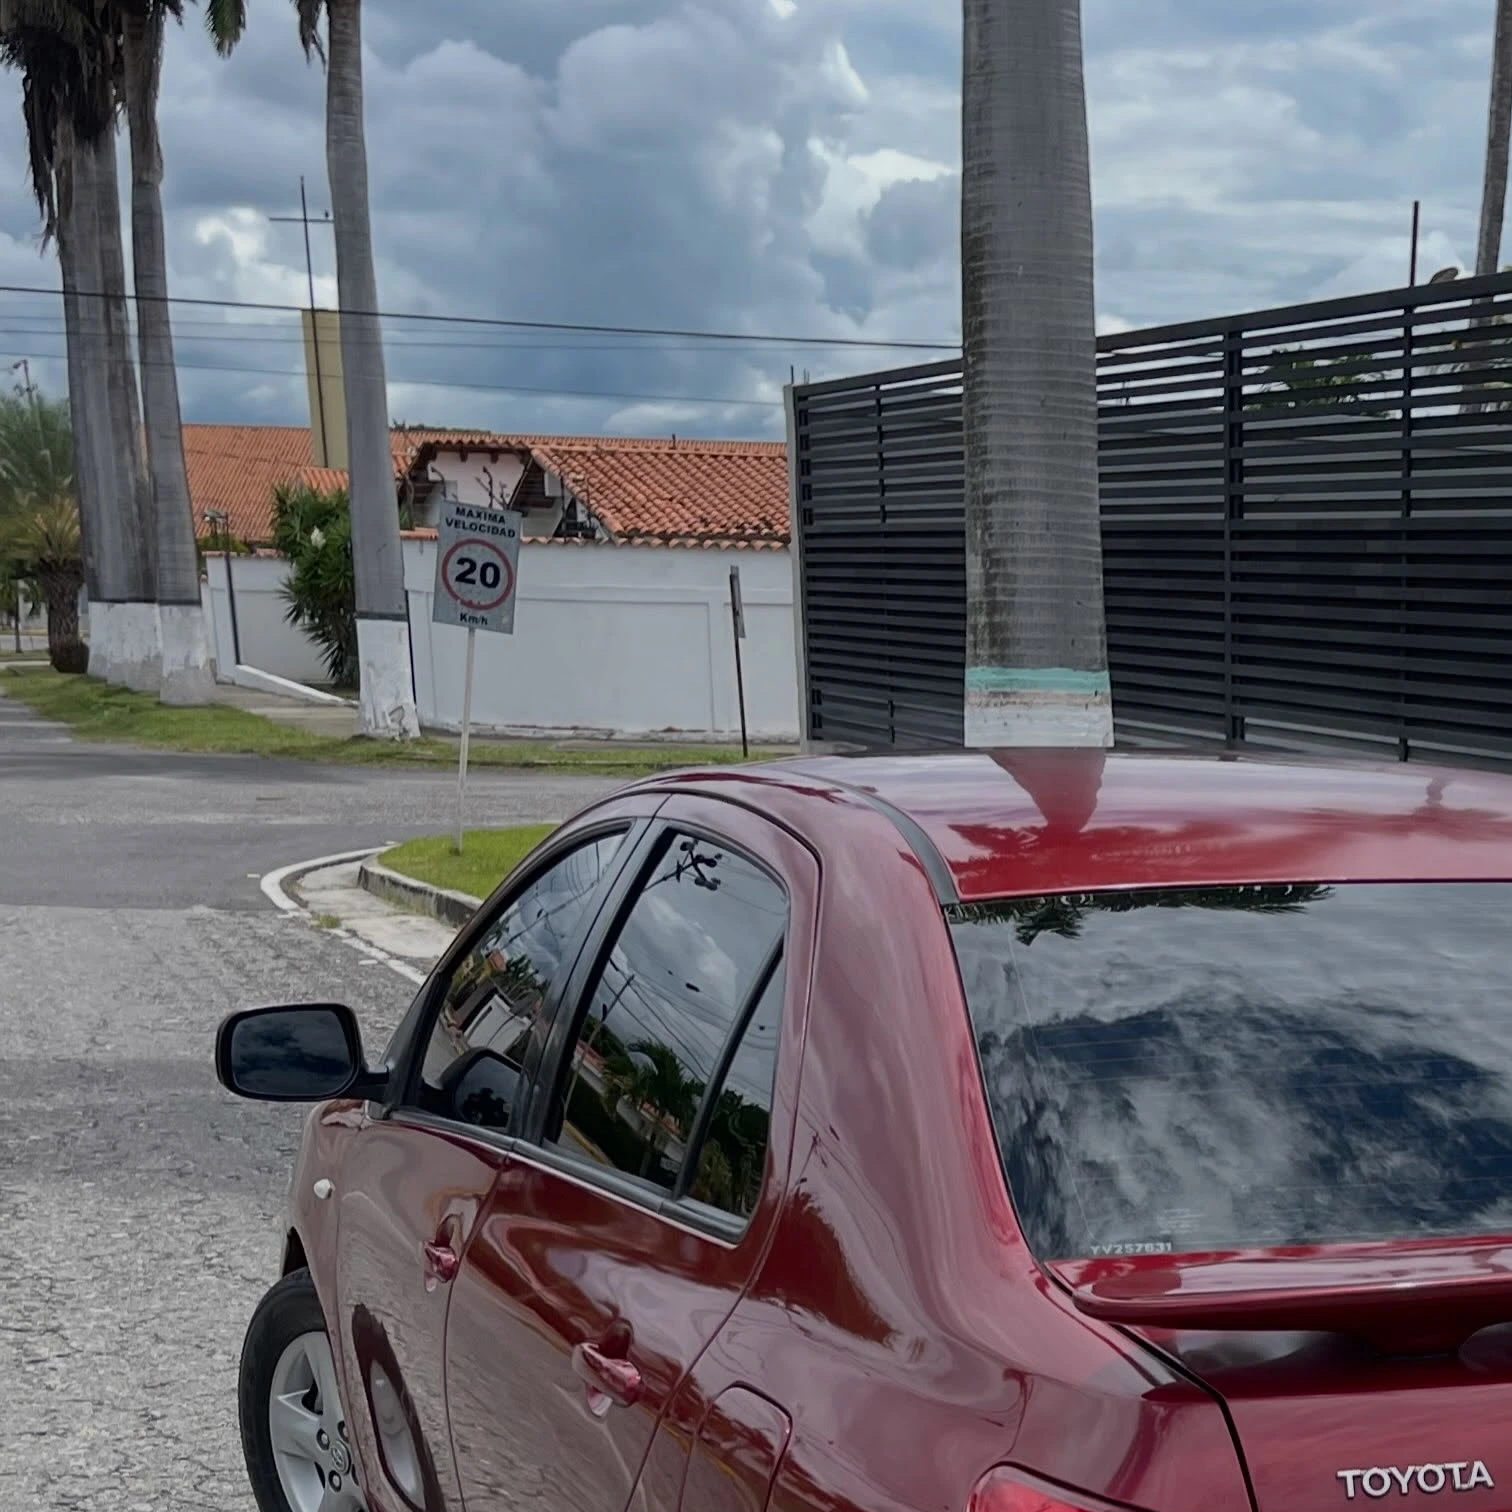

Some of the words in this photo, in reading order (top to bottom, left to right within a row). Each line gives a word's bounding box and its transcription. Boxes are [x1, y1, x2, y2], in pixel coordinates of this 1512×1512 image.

[455, 506, 506, 525] MAXIMA
[445, 517, 516, 538] VELOCIDAD
[455, 557, 500, 589] 20
[459, 612, 488, 625] Km/h
[1337, 1460, 1495, 1499] TOYOTA
